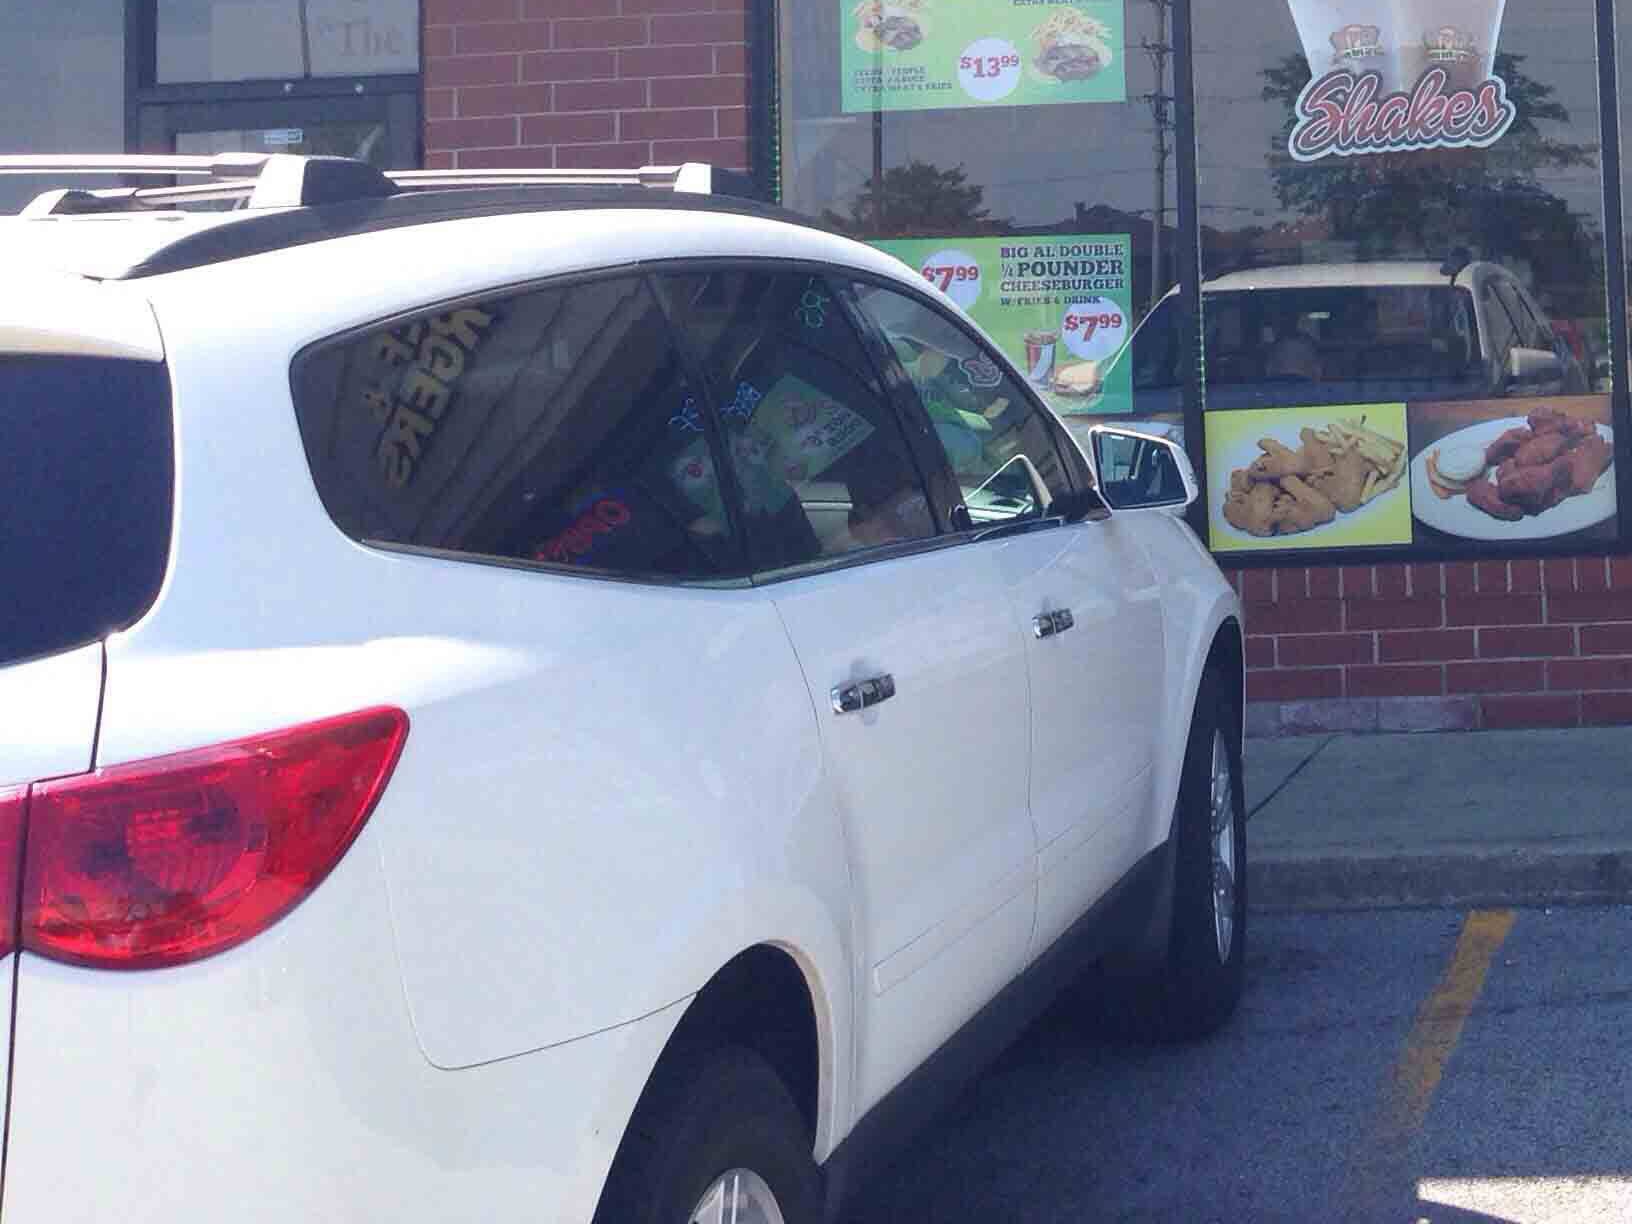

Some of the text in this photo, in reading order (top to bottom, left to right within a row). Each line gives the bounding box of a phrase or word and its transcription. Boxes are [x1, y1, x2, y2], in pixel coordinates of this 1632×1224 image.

[1294, 66, 1510, 157] Shakes
[1060, 243, 1124, 257] DOUBLE
[1017, 260, 1125, 278] POUNDER
[1000, 278, 1125, 292] CHEESEBURGER
